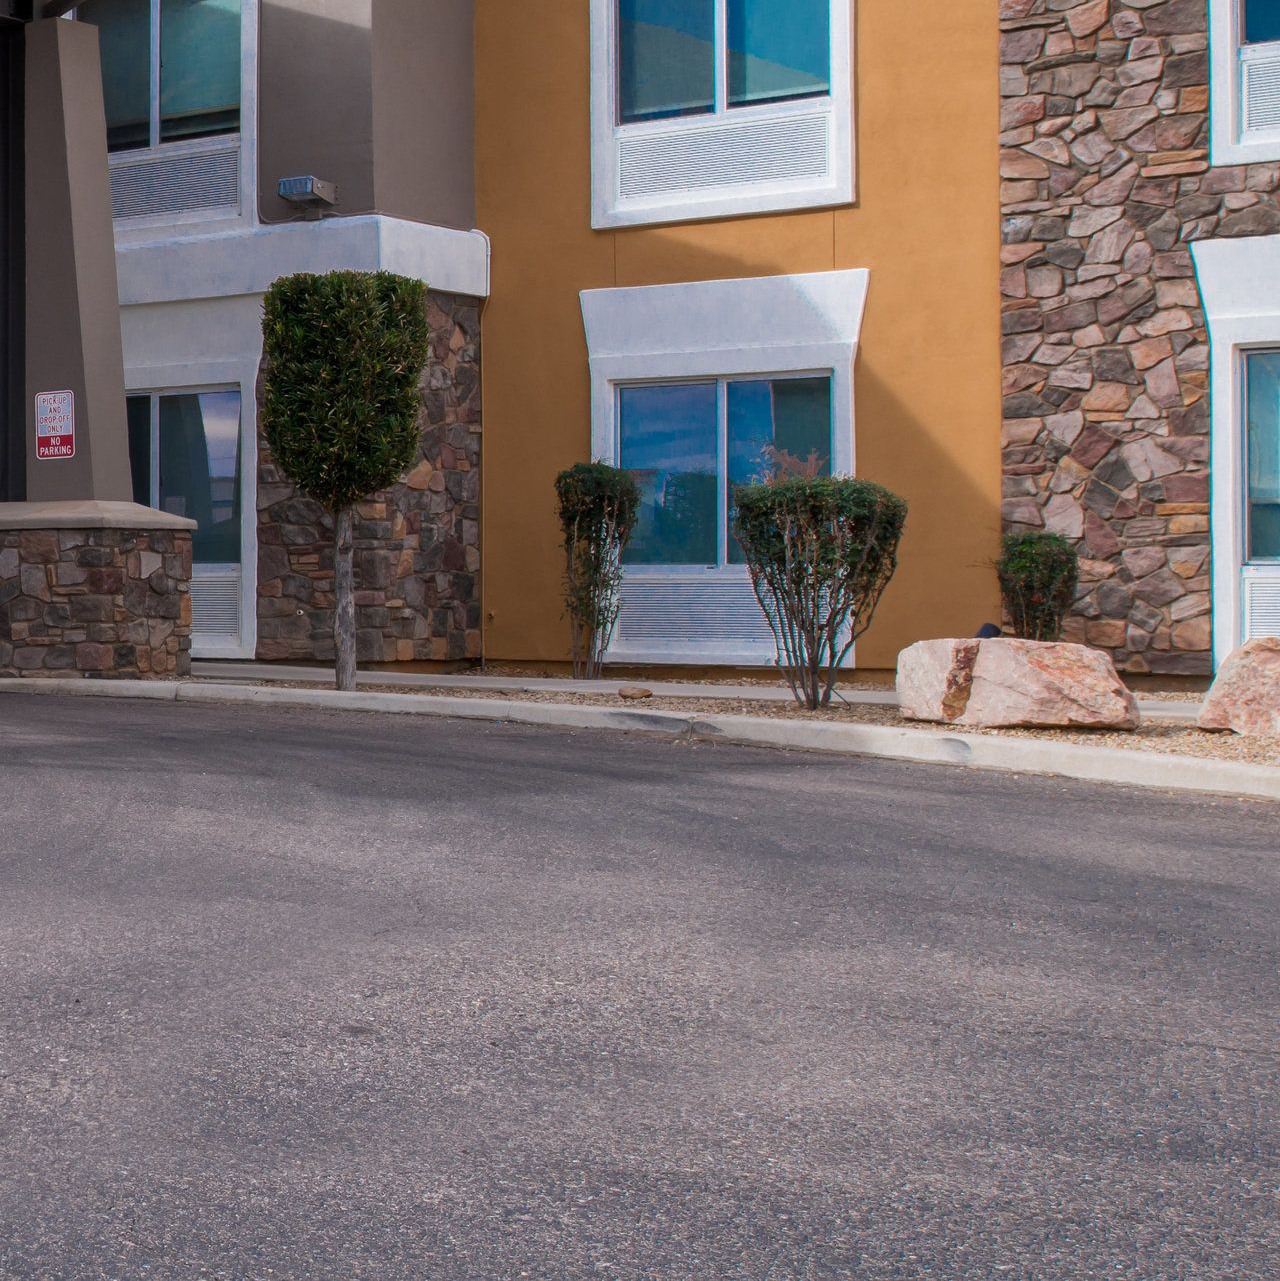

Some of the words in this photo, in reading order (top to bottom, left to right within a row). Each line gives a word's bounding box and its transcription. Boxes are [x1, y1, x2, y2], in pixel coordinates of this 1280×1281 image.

[48, 406, 62, 414] AND
[47, 425, 64, 433] ONLY
[50, 436, 61, 446] NO
[40, 446, 71, 456] PARKING
